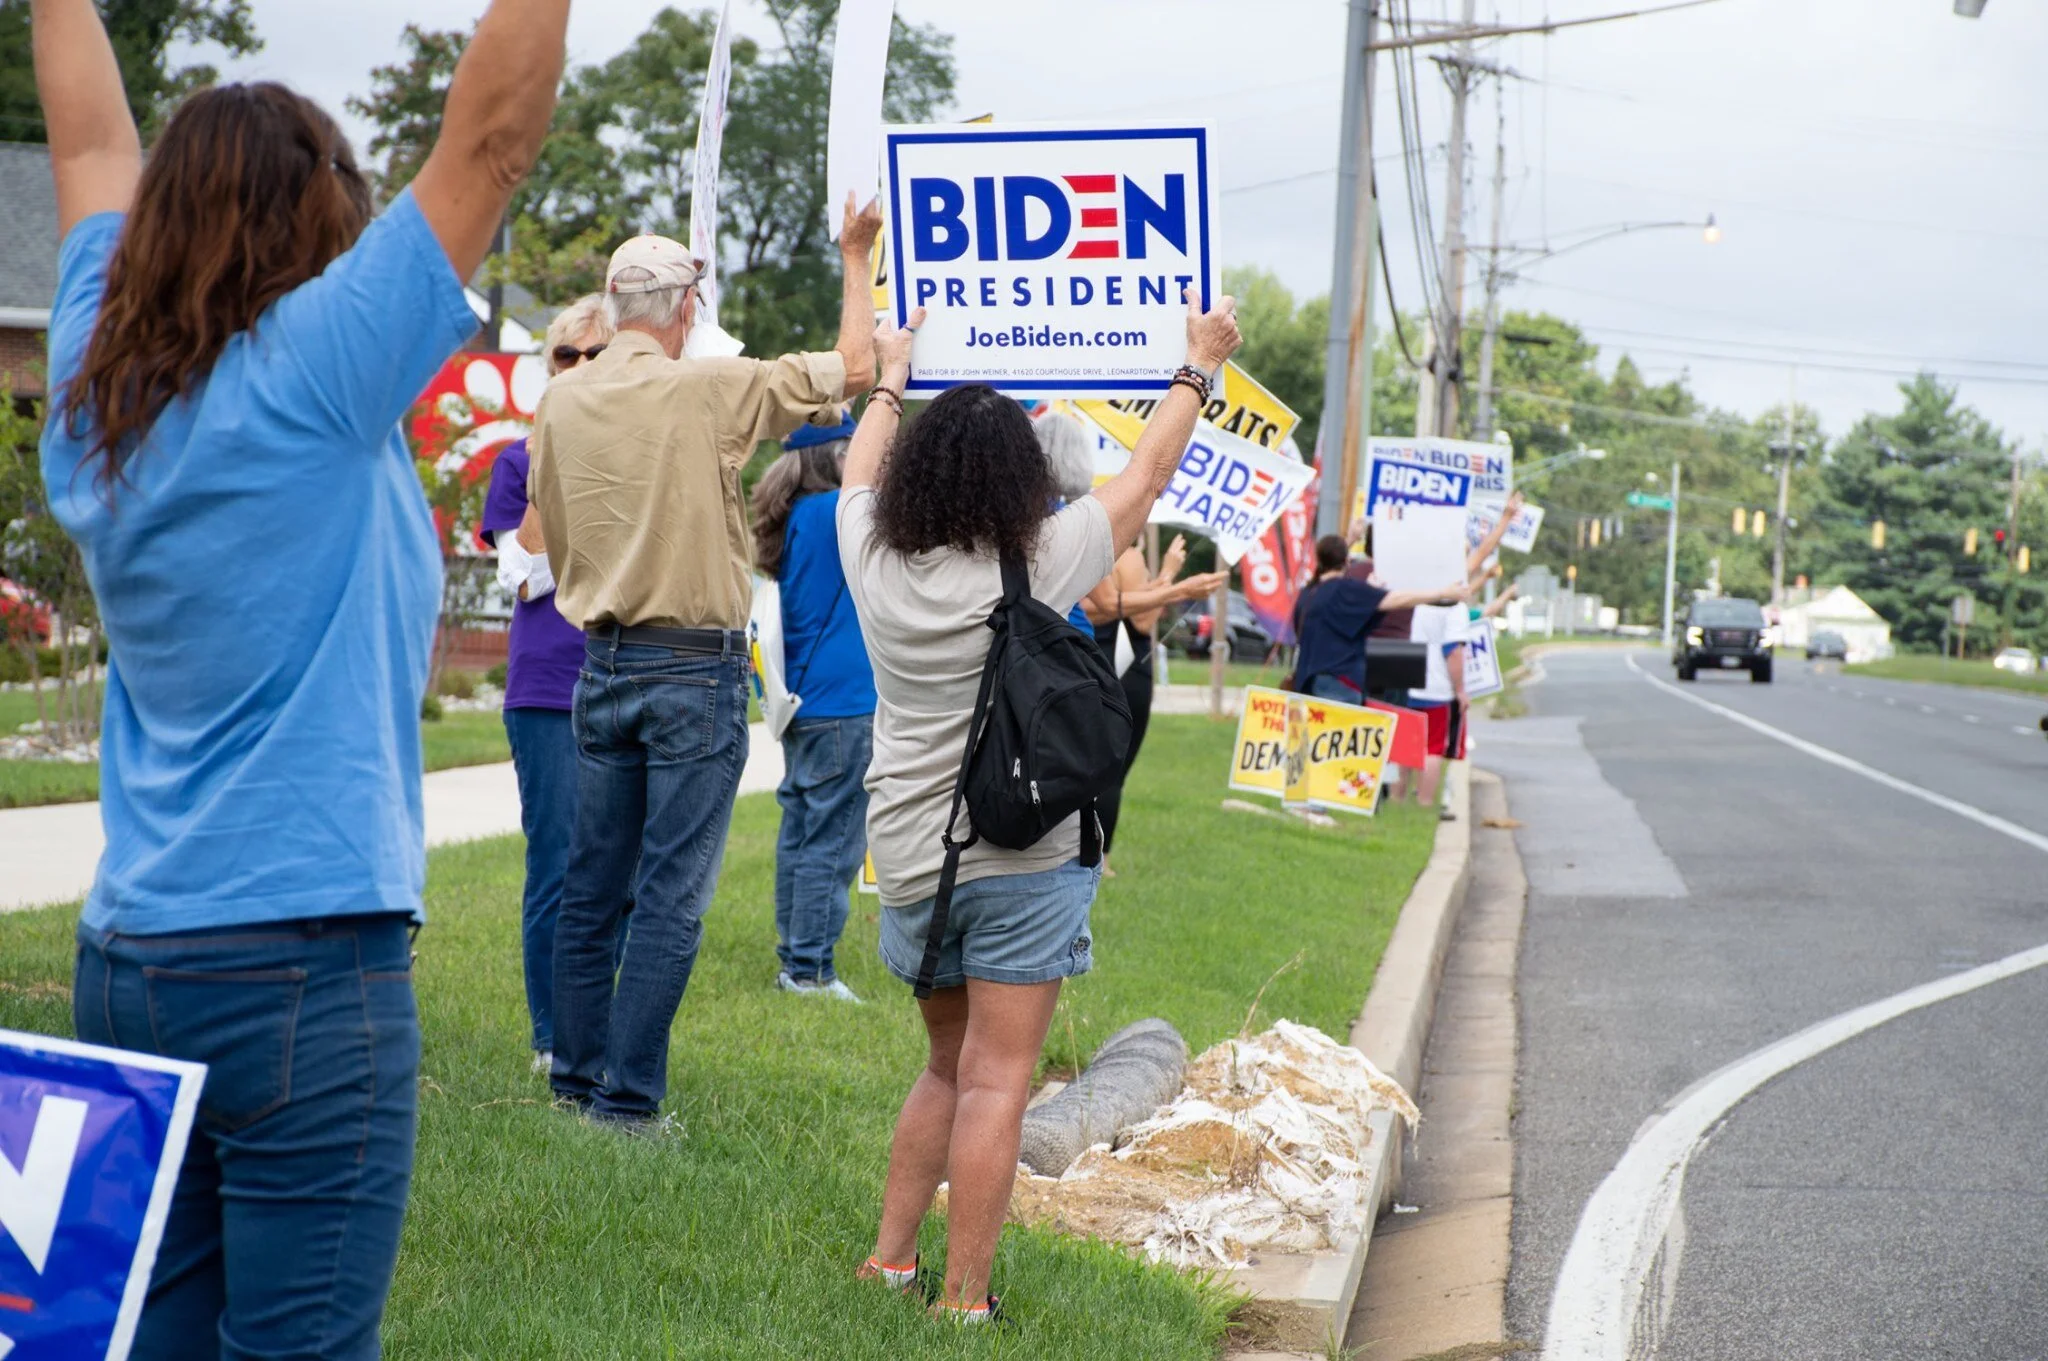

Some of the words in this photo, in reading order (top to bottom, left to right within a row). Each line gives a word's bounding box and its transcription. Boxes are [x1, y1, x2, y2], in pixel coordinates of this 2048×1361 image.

[910, 173, 1188, 262] BIDEN
[916, 275, 1194, 308] PRESIDENT
[966, 325, 1147, 348] JoeBiden.com
[1035, 368, 1080, 376] COURTHOUSE
[1163, 368, 1174, 376] MD
[1431, 450, 1503, 474] BIDEN
[1178, 441, 1294, 514] BIDEN
[1378, 463, 1462, 503] BIDEN
[1474, 475, 1504, 491] RIS
